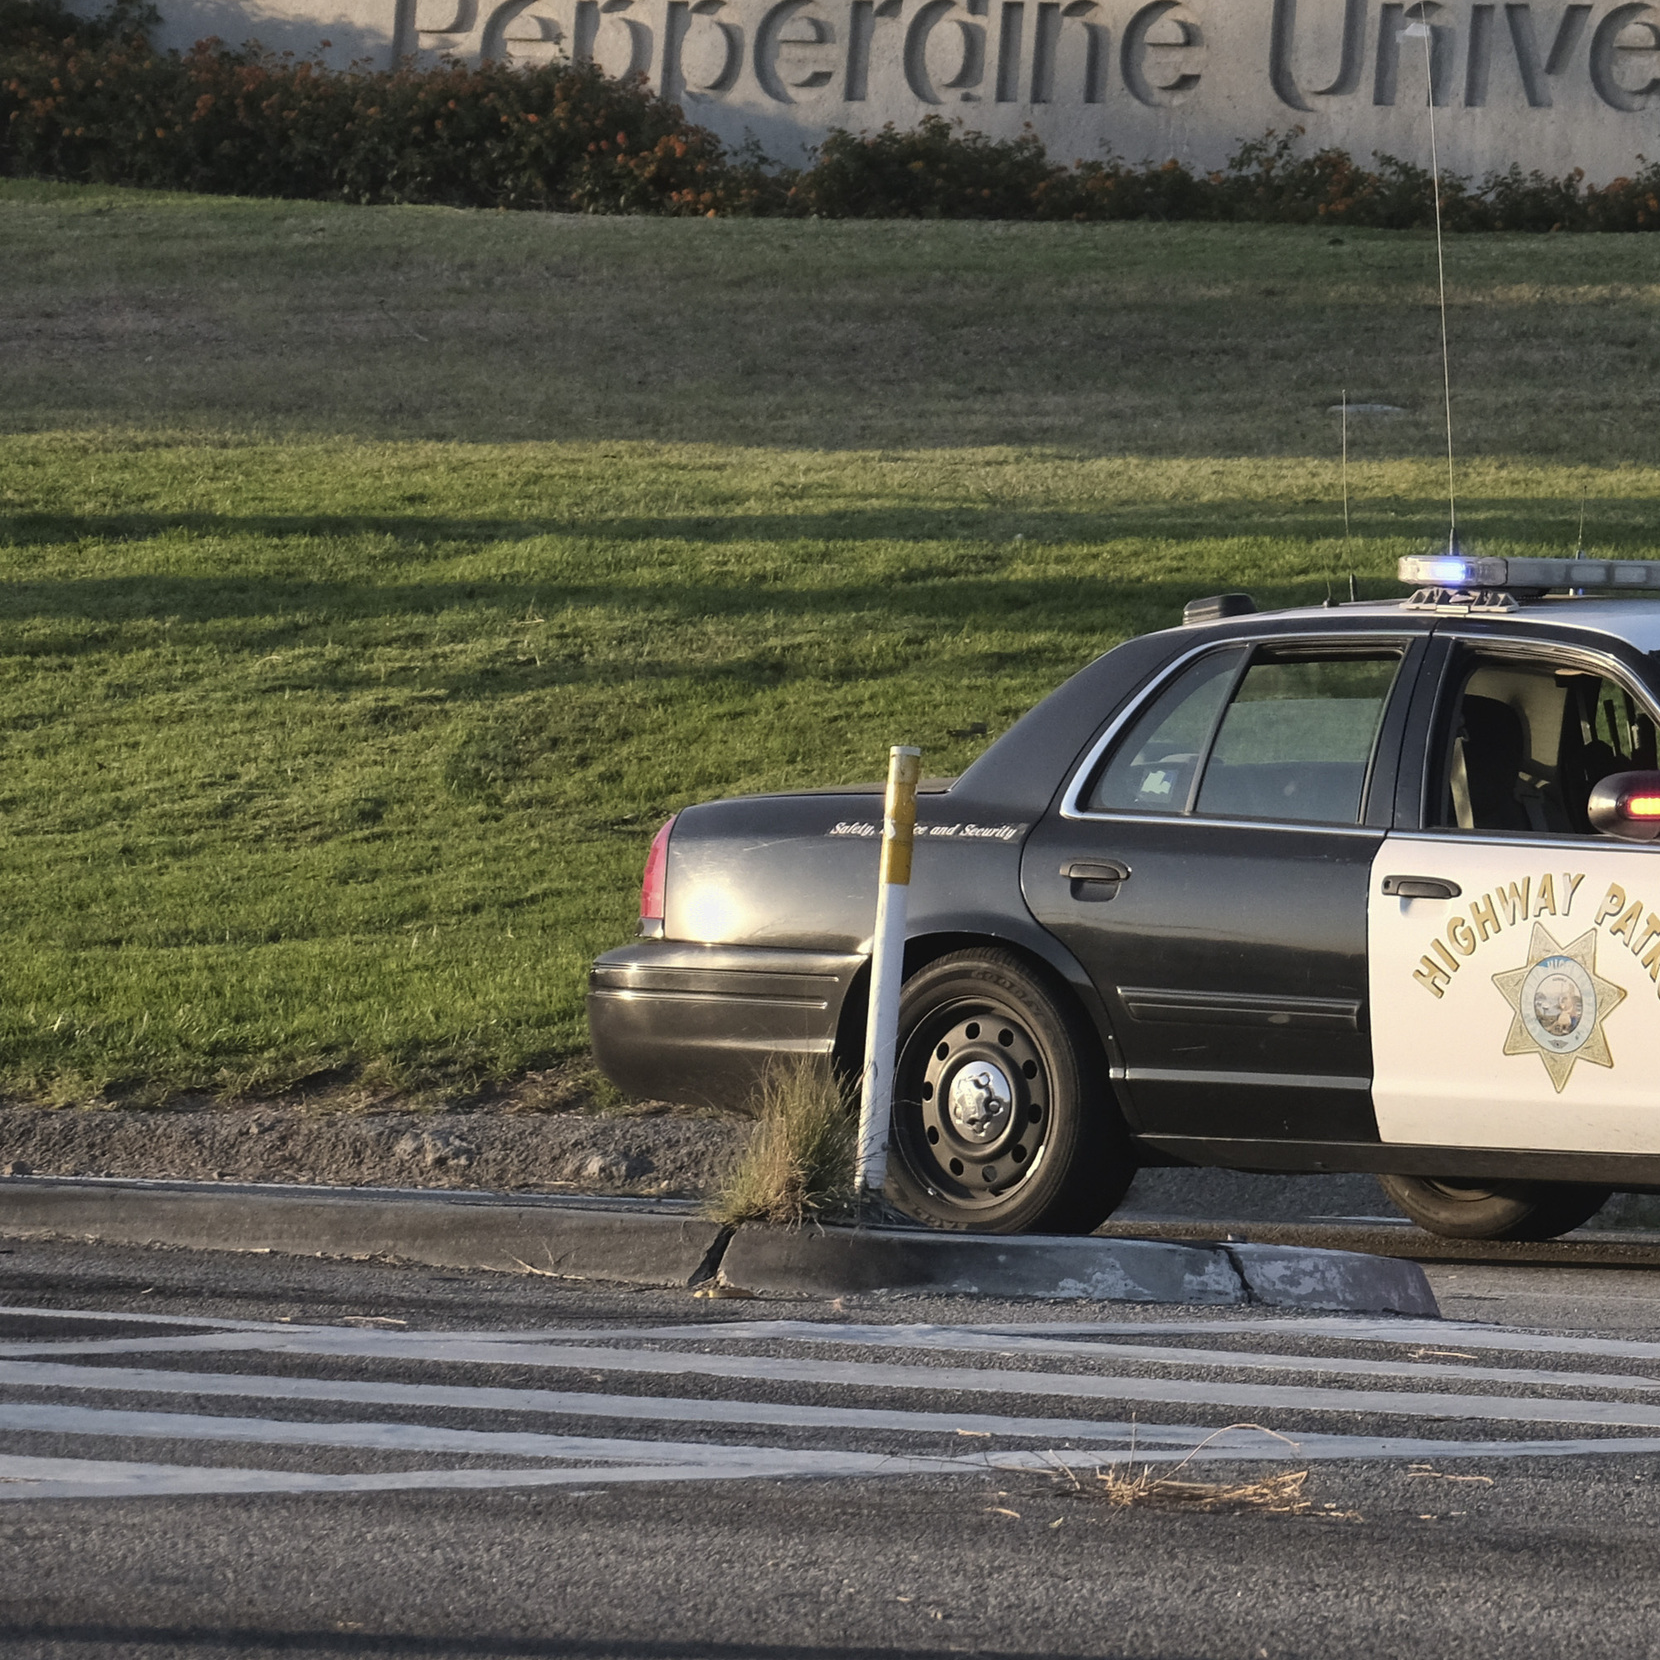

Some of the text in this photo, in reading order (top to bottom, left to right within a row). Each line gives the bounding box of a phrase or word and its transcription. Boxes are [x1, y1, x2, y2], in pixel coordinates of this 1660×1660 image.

[829, 821, 875, 838] Safety,
[929, 823, 960, 837] and
[958, 823, 1018, 840] Security
[1411, 872, 1585, 1000] HIGHWAY
